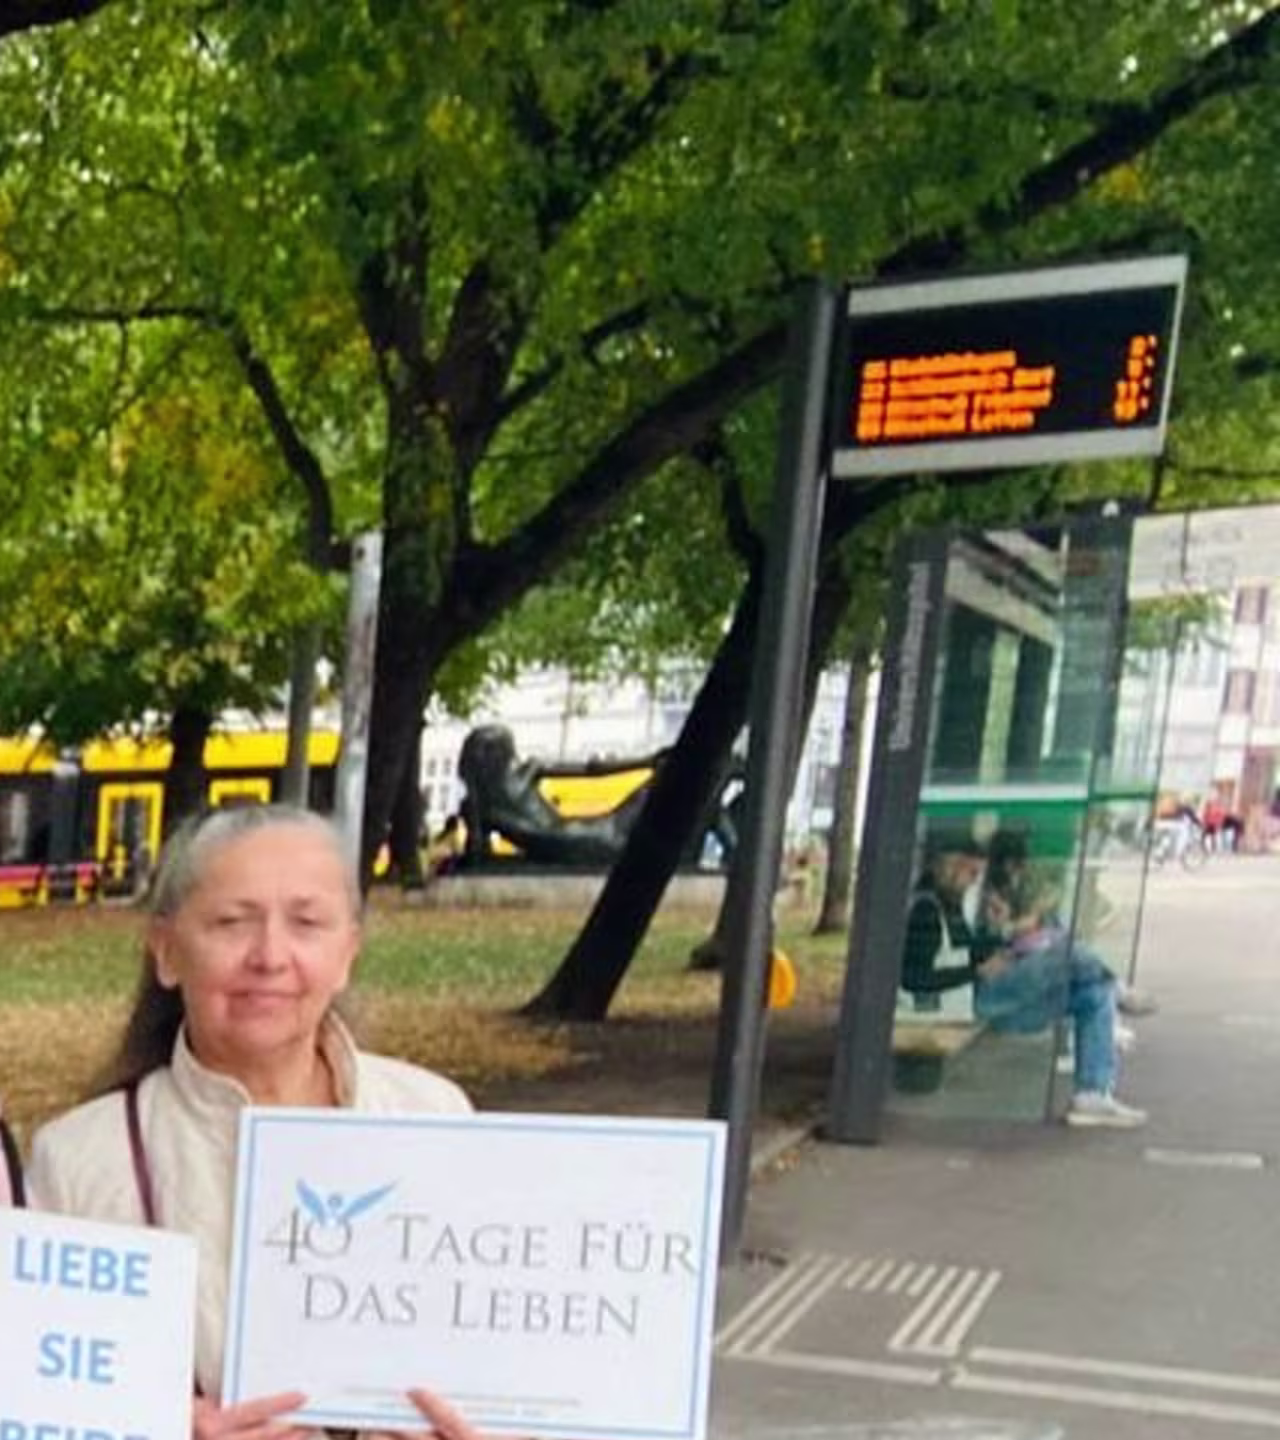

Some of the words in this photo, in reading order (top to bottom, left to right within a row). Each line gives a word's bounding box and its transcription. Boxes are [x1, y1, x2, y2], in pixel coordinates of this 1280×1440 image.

[13, 1236, 151, 1297] LIEBE
[263, 1207, 352, 1265] 40
[387, 1214, 548, 1268] TAGE
[578, 1220, 698, 1277] FÜR
[303, 1273, 418, 1325] DAS
[450, 1280, 639, 1337] LEBEN
[37, 1332, 117, 1384] SIE
